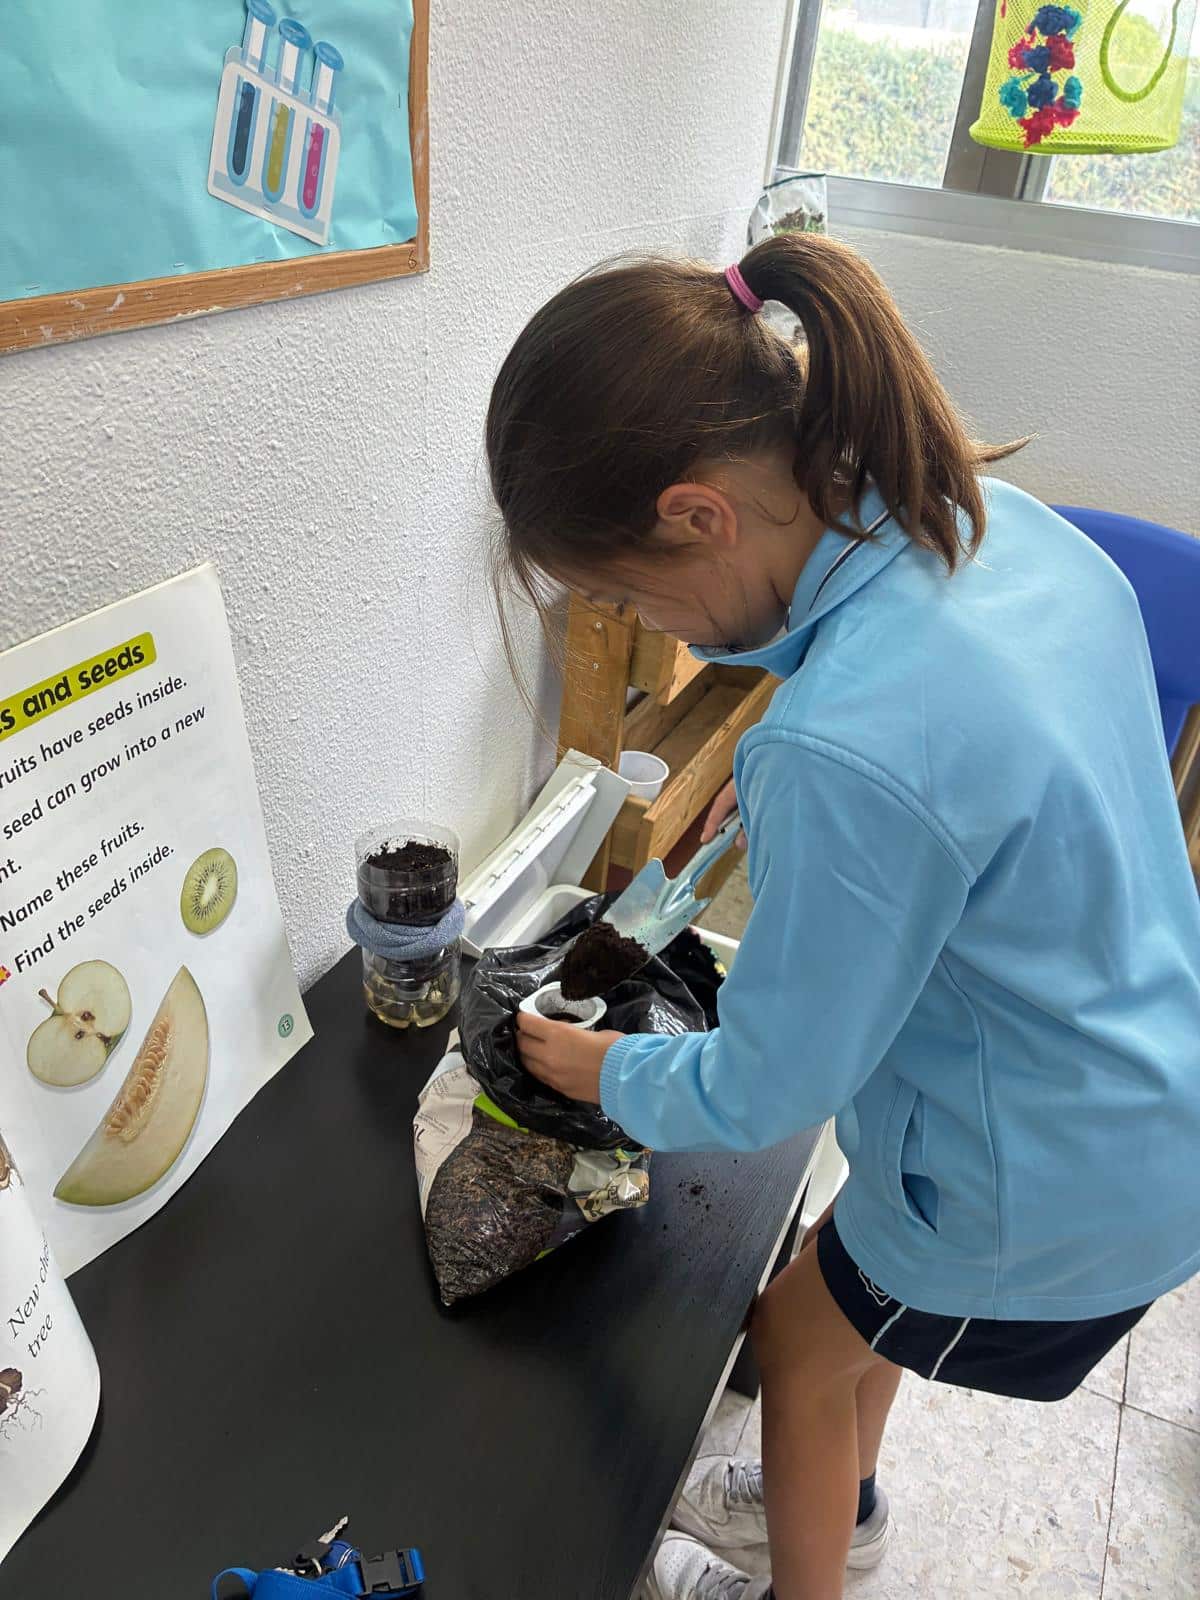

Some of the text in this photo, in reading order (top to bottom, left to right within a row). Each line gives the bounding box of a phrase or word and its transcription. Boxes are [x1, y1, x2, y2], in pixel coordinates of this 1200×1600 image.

[0, 645, 145, 735] s and seeds
[40, 730, 84, 762] have
[88, 701, 133, 736] seeds
[136, 677, 187, 709] inside.
[3, 706, 205, 840] seed can grow into a new
[0, 821, 145, 933] Name these fruits.
[14, 845, 175, 973] Find the seeds inside.
[7, 1284, 40, 1339] New
[28, 1314, 53, 1358] tree
